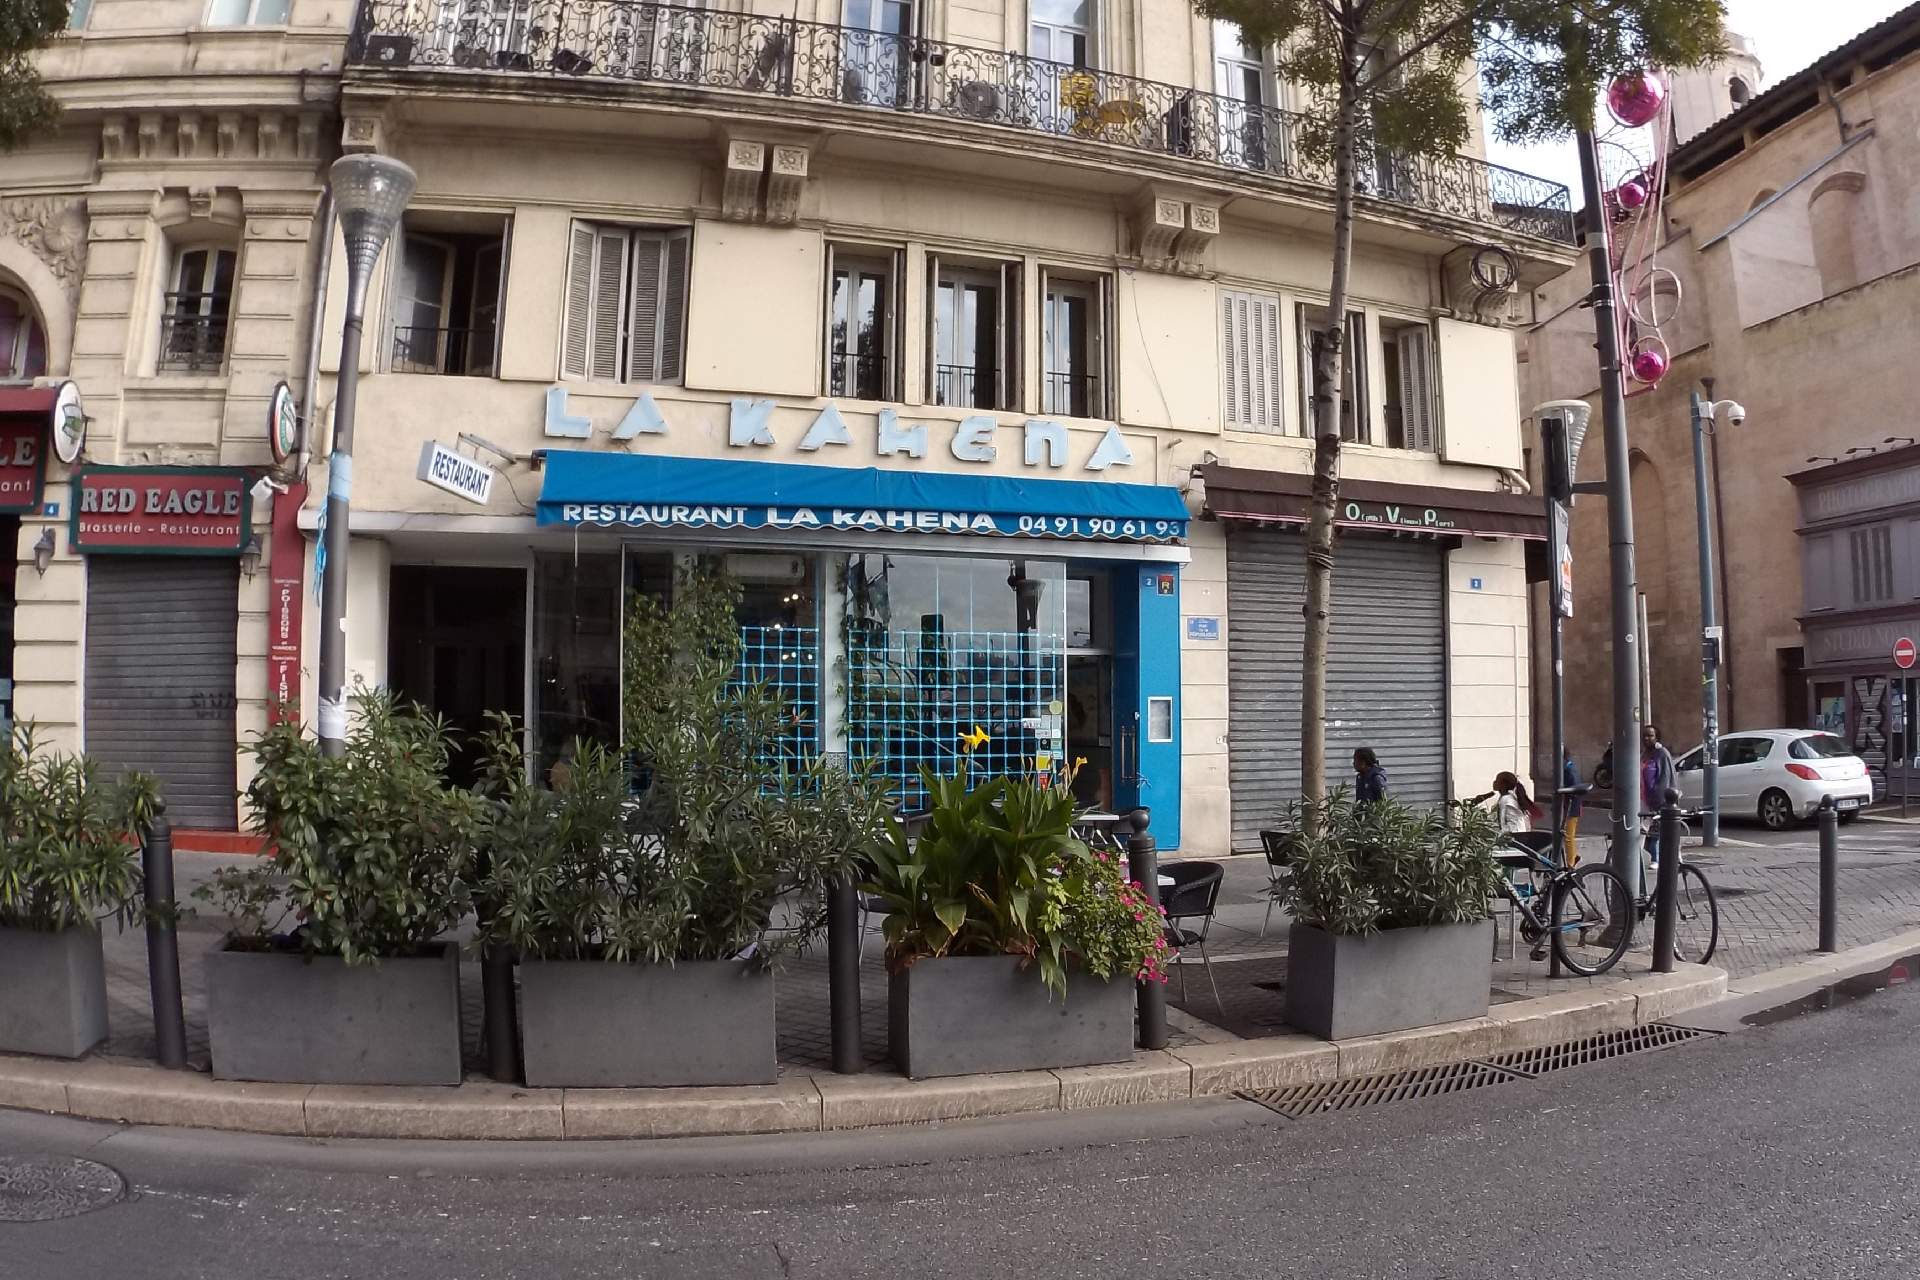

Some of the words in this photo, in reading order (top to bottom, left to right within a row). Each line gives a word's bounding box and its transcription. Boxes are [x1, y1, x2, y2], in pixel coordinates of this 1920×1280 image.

[545, 387, 669, 440] LA
[432, 451, 490, 498] RESTAURANT
[48, 504, 54, 514] 4
[80, 487, 136, 513] RED
[144, 488, 240, 515] EAGLE
[79, 522, 141, 534] Brasserie
[160, 523, 240, 535] Restaurant
[563, 503, 748, 523] RESTAURANT
[767, 507, 820, 524] LA
[1019, 515, 1048, 532] 04
[1054, 517, 1079, 533] 91
[1089, 518, 1116, 534] 90
[1122, 520, 1146, 535] 61
[1155, 521, 1180, 535] 93
